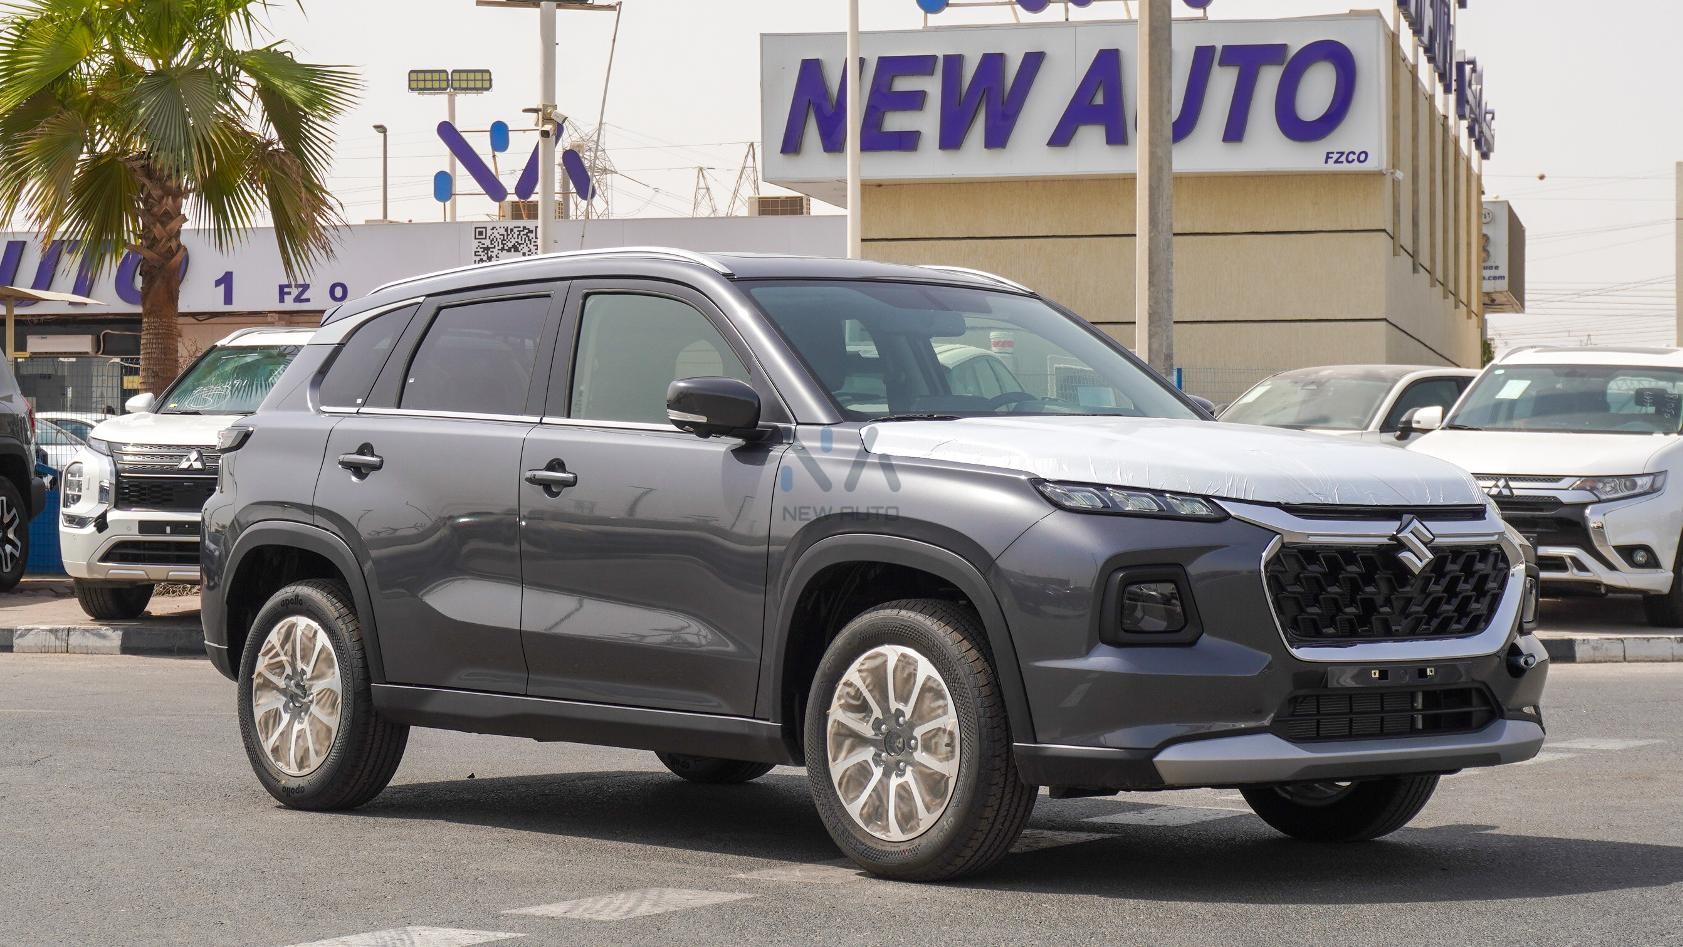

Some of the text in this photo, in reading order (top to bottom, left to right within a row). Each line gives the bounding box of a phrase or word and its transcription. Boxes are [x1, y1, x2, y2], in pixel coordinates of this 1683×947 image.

[780, 51, 1046, 154] NEW
[1324, 150, 1369, 165] FZCO
[214, 271, 234, 306] 1
[281, 594, 303, 608] apollo
